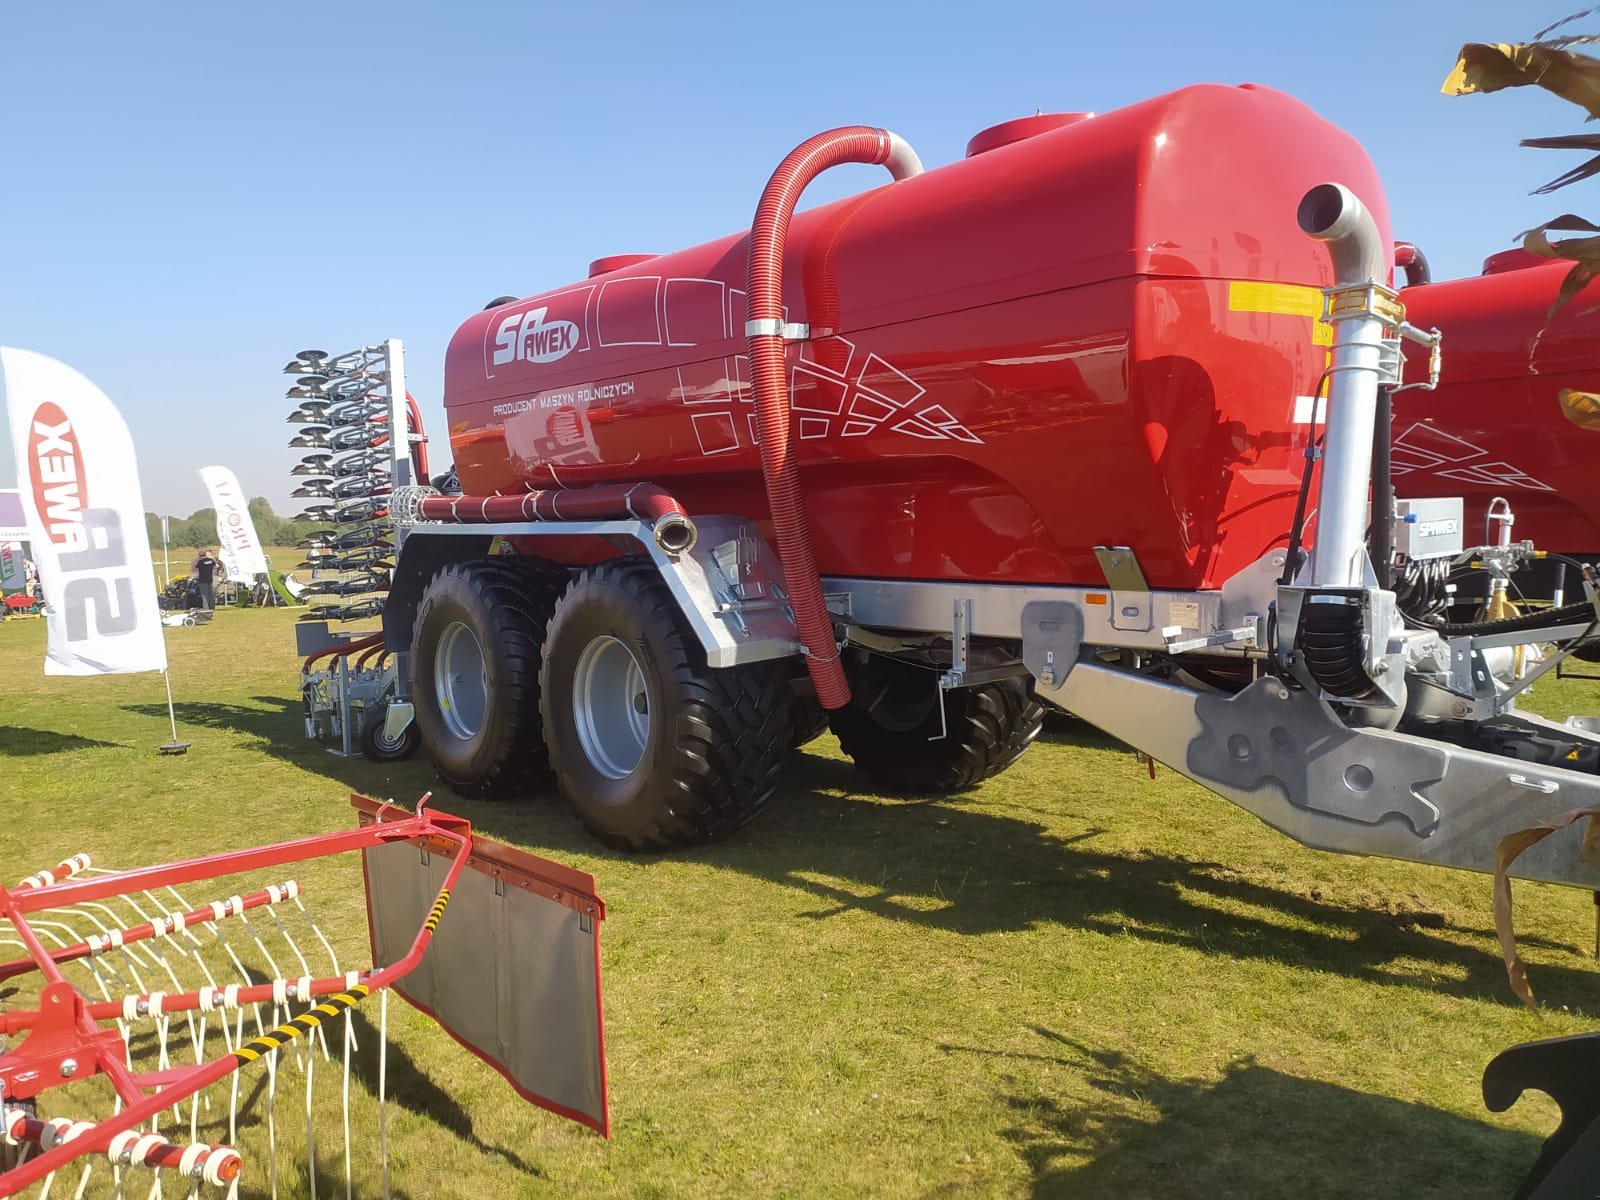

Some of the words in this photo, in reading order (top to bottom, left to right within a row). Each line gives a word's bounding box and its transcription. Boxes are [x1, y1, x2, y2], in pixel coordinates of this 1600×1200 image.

[493, 399, 538, 416] PRODUCENT
[540, 392, 575, 409] MASZYN
[577, 381, 634, 402] ROLNICZYCH
